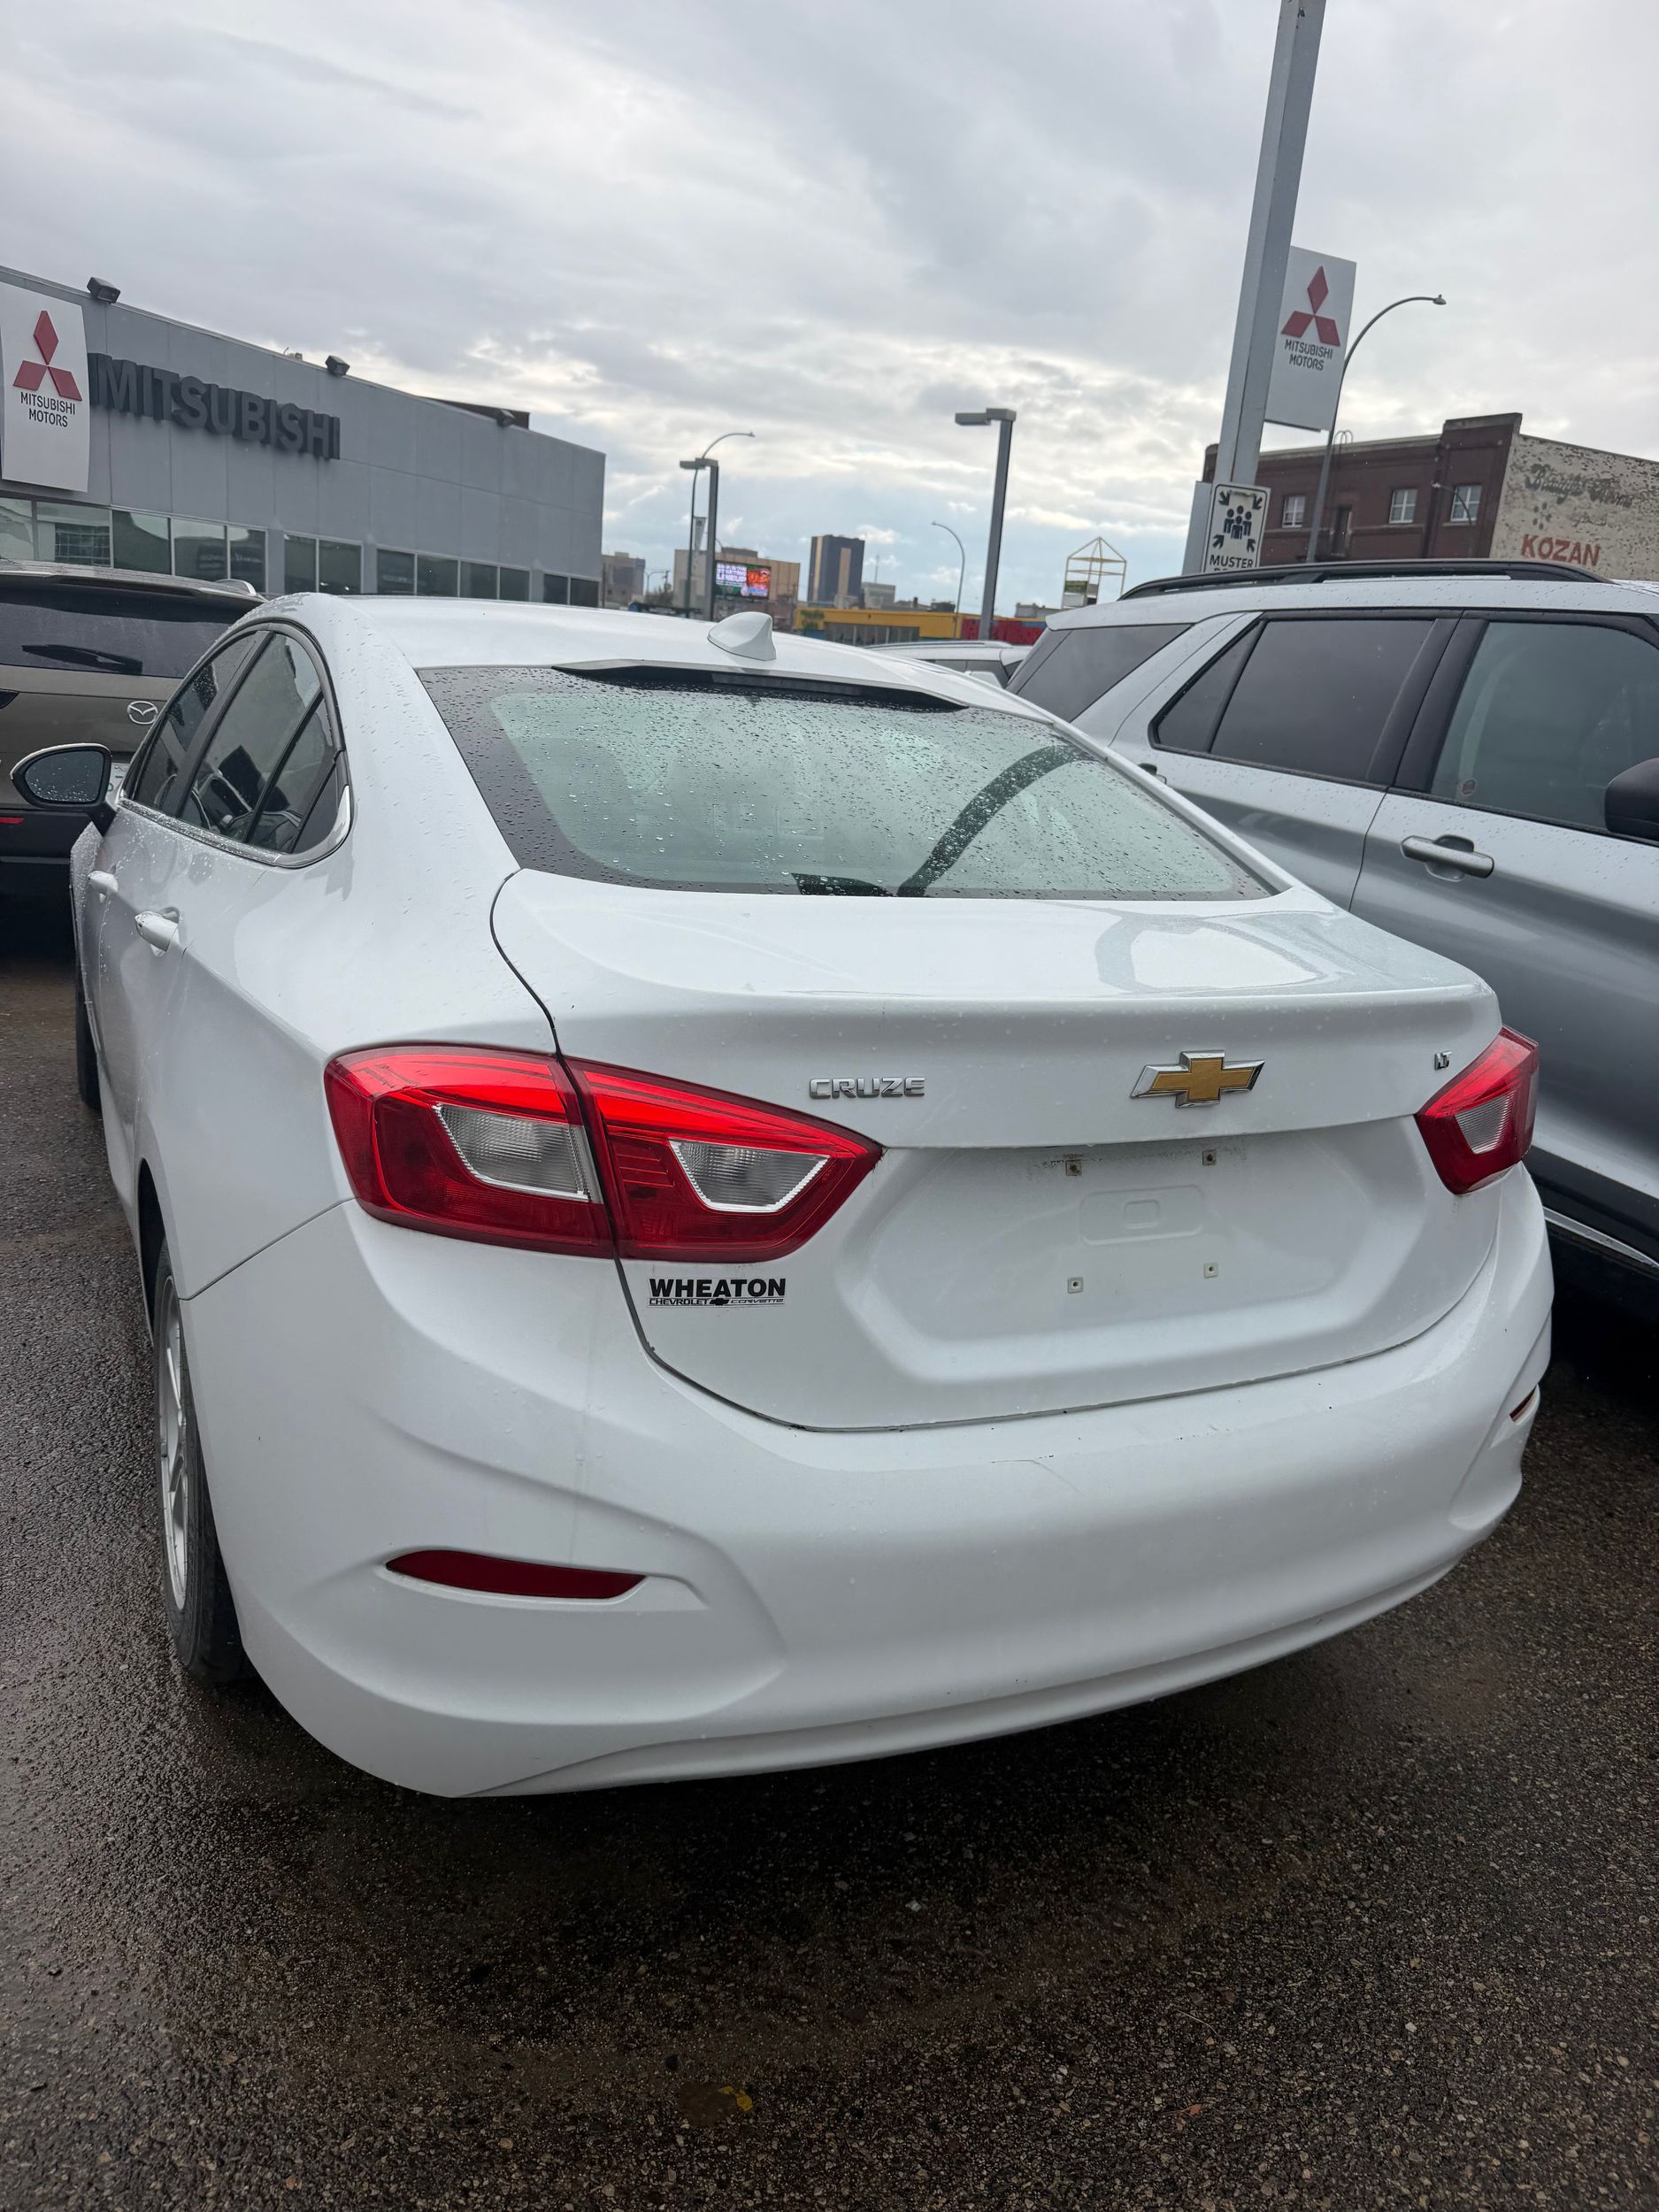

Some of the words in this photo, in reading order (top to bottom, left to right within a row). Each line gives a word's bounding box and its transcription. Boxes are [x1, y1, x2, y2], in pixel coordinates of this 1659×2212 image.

[1284, 339, 1333, 359] MITSUBISHI
[1289, 354, 1325, 371] MOTORS
[20, 391, 76, 415] MITSUBISHI
[88, 352, 341, 460] MITSUBISHI
[28, 408, 68, 427] MOTORS
[1520, 534, 1601, 567] KOZAN
[1210, 554, 1254, 569] MUSTER
[809, 1077, 926, 1099] CRUZE
[649, 1278, 786, 1298] WHEATON
